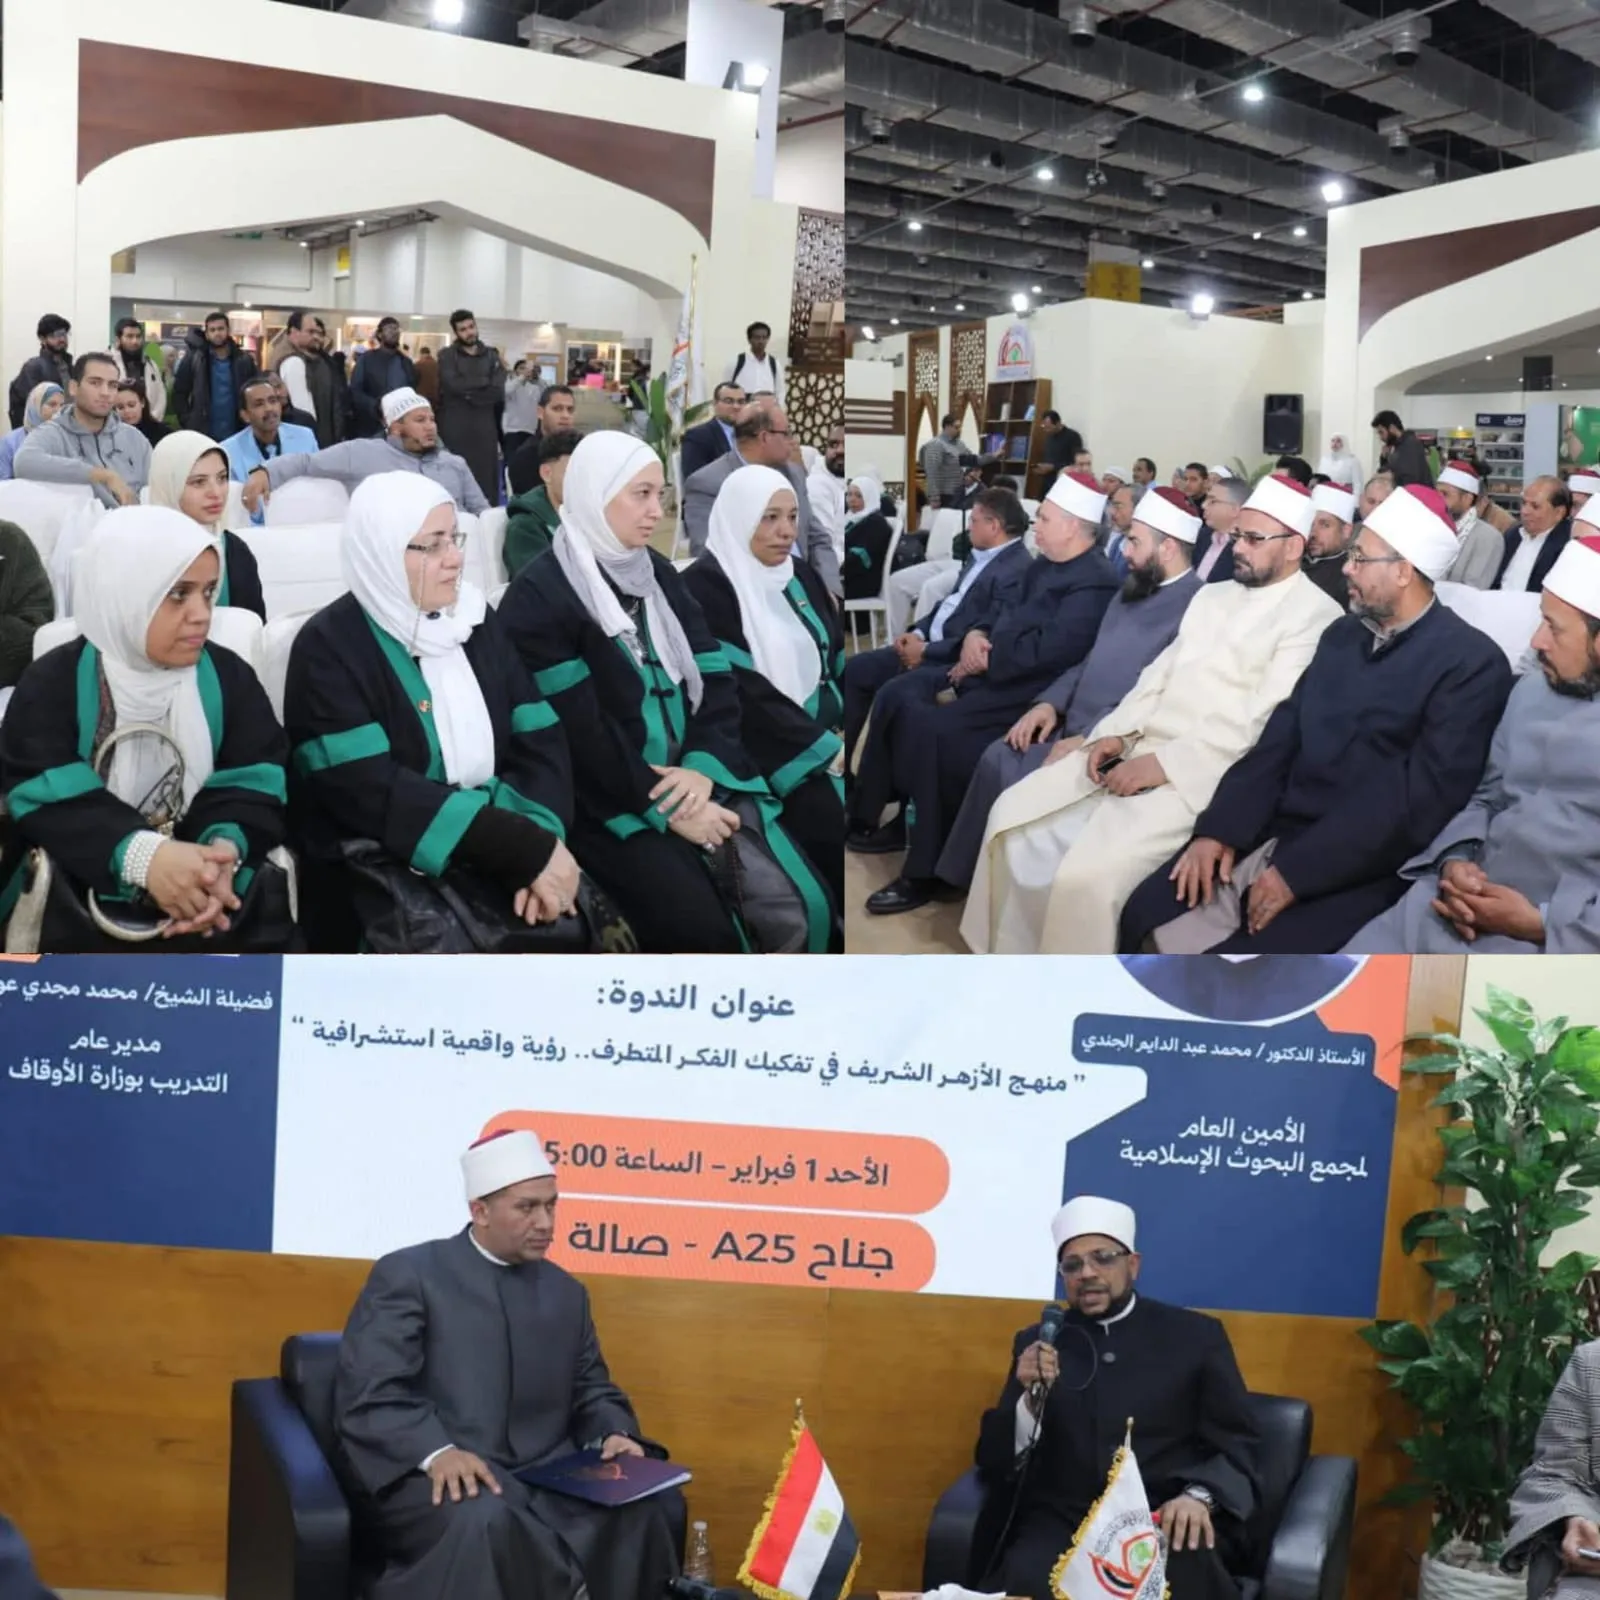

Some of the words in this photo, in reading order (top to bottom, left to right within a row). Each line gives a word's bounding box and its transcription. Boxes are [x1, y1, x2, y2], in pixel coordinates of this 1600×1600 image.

[0, 980, 17, 995] عو
[23, 982, 80, 1000] مجدي
[86, 986, 137, 999] محمد
[598, 980, 696, 1013] الندوة:
[216, 990, 272, 1011] فضيلة
[712, 988, 794, 1022] عنوان
[70, 1029, 109, 1049] عام
[313, 1020, 434, 1048] استشرافية
[443, 1030, 514, 1058] واقعية
[1082, 1034, 1133, 1052] الجندي
[1136, 1037, 1178, 1053] الدايم
[112, 1038, 161, 1056] مدير
[523, 1036, 565, 1061] رؤية
[676, 1048, 736, 1069] الفكر
[1182, 1041, 1207, 1056] عبد
[1210, 1043, 1252, 1058] محمد
[1317, 1047, 1366, 1067] الأستاذ
[9, 1057, 83, 1086] الأوقاف
[745, 1052, 814, 1076] تفكيك
[820, 1052, 838, 1086] في
[848, 1060, 932, 1084] الشريف
[937, 1063, 1001, 1090] الأزهر
[91, 1065, 143, 1092] بوزارة
[151, 1074, 227, 1095] التدريب
[1009, 1075, 1066, 1096] منهج
[1179, 1116, 1234, 1138] العام
[1241, 1117, 1304, 1144] الأمين
[616, 1147, 701, 1174] الساعة
[1120, 1138, 1222, 1173] الإسلامية
[1227, 1146, 1304, 1176] البحوث
[729, 1155, 795, 1185] فبراير
[806, 1159, 816, 1181] 1
[825, 1157, 888, 1186] الأحد
[1310, 1157, 1368, 1182] لمجمع
[569, 1223, 668, 1256] صالة
[712, 1232, 794, 1263] A25
[808, 1238, 893, 1280] جناح
